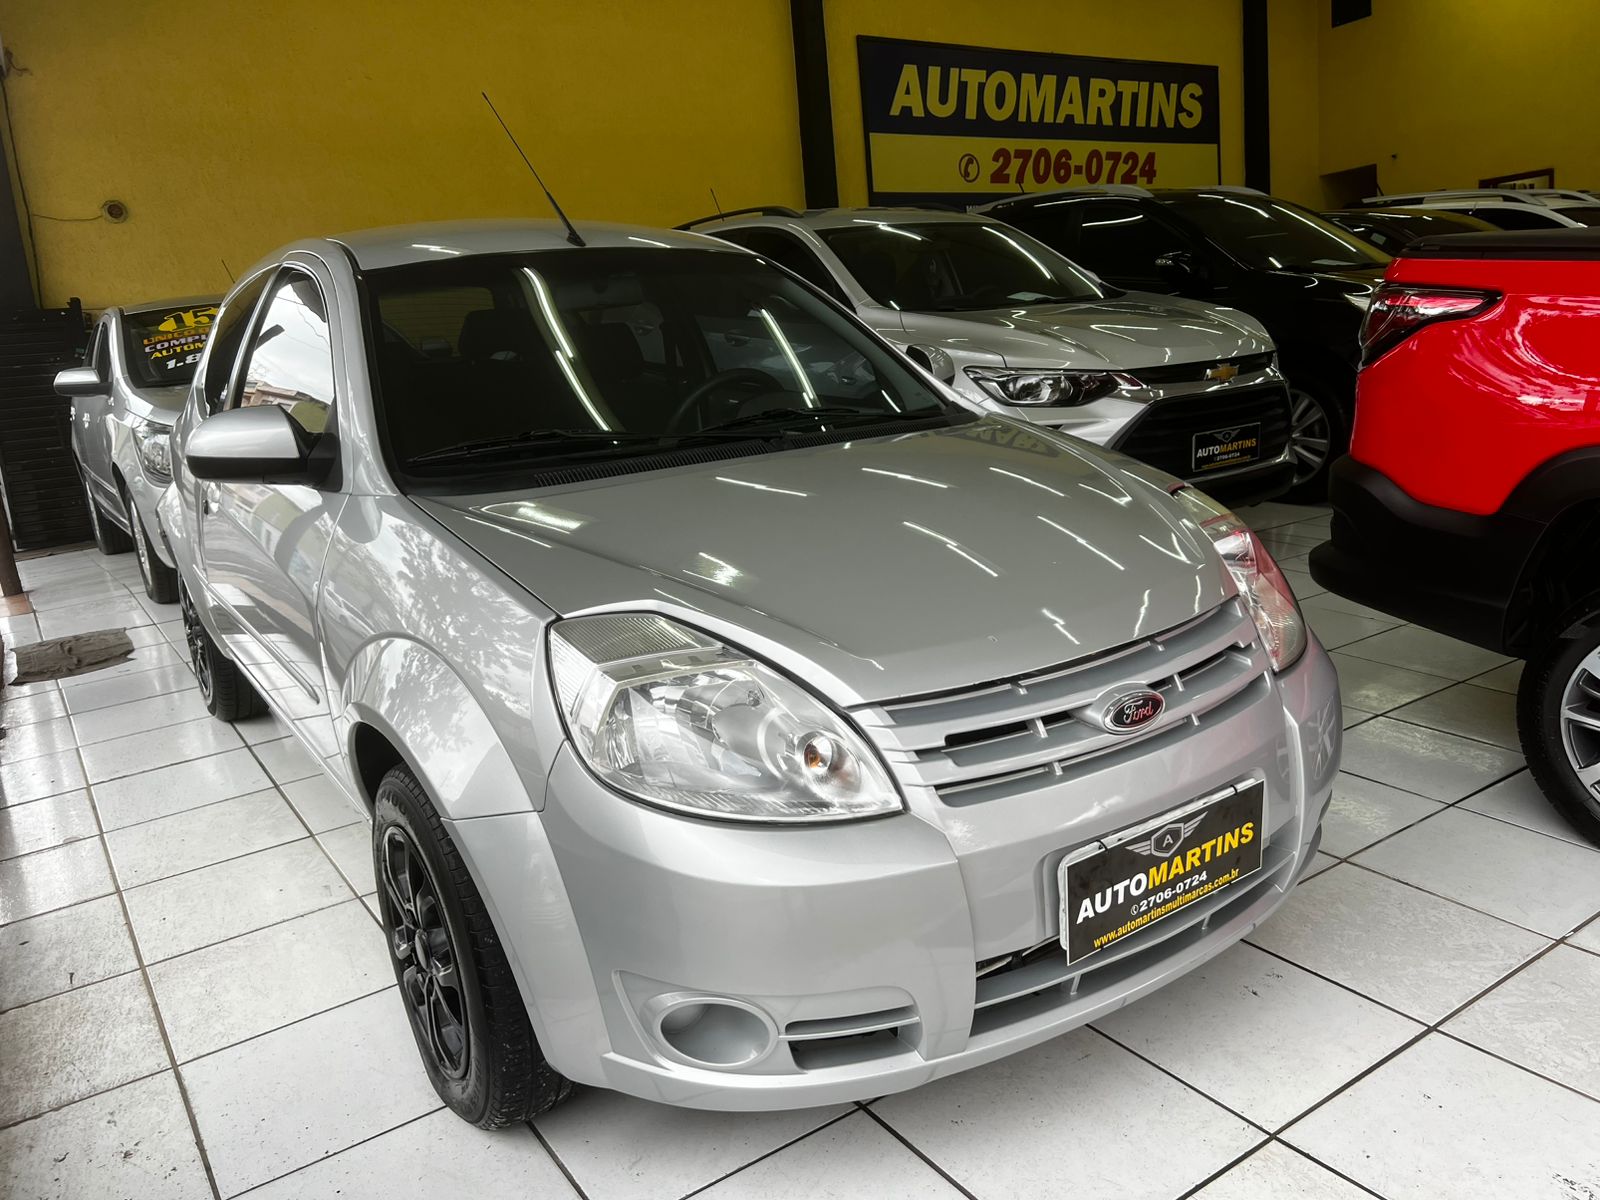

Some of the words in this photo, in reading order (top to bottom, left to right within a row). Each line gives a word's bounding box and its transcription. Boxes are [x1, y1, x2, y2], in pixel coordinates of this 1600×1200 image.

[889, 63, 1204, 129] AUTOMARTINS
[989, 147, 1157, 184] 2706-0724
[145, 335, 208, 352] COMPL
[151, 342, 205, 360] AUTOM
[1196, 438, 1257, 458] AUTOMARTINS
[1123, 700, 1154, 724] Ford
[1162, 834, 1174, 848] A
[1076, 822, 1254, 925] AUTOMARTINS
[1139, 870, 1208, 912] 2706-0724
[1093, 867, 1240, 949] www.automartinsmultimarcas.com.br
